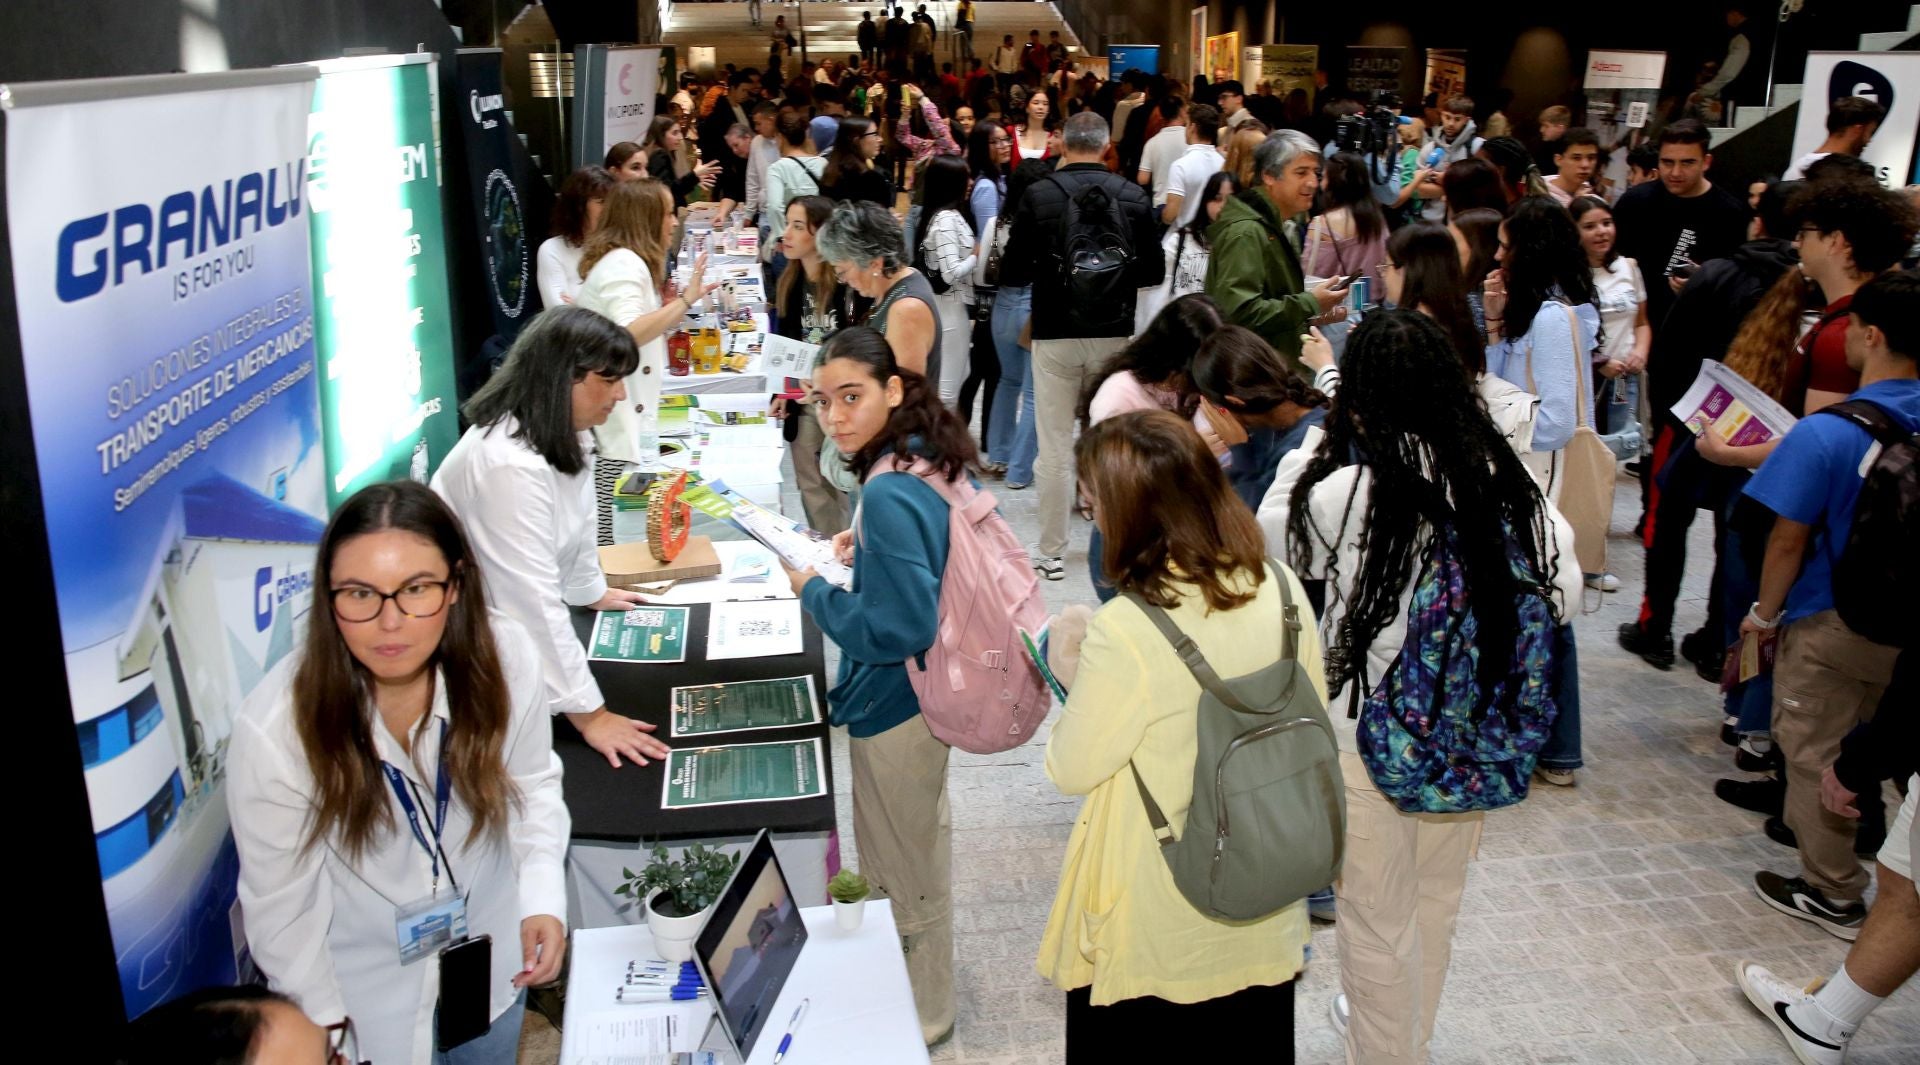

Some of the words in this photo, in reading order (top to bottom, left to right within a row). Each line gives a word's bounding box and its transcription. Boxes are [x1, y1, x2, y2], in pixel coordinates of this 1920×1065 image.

[173, 273, 189, 301] IS
[193, 257, 222, 293] FOR
[226, 244, 254, 277] YOU
[108, 335, 211, 419] SOLUCIONES
[212, 294, 291, 356] INTEGRALES
[97, 377, 213, 475] TRANSPORTE
[214, 362, 236, 398] DE
